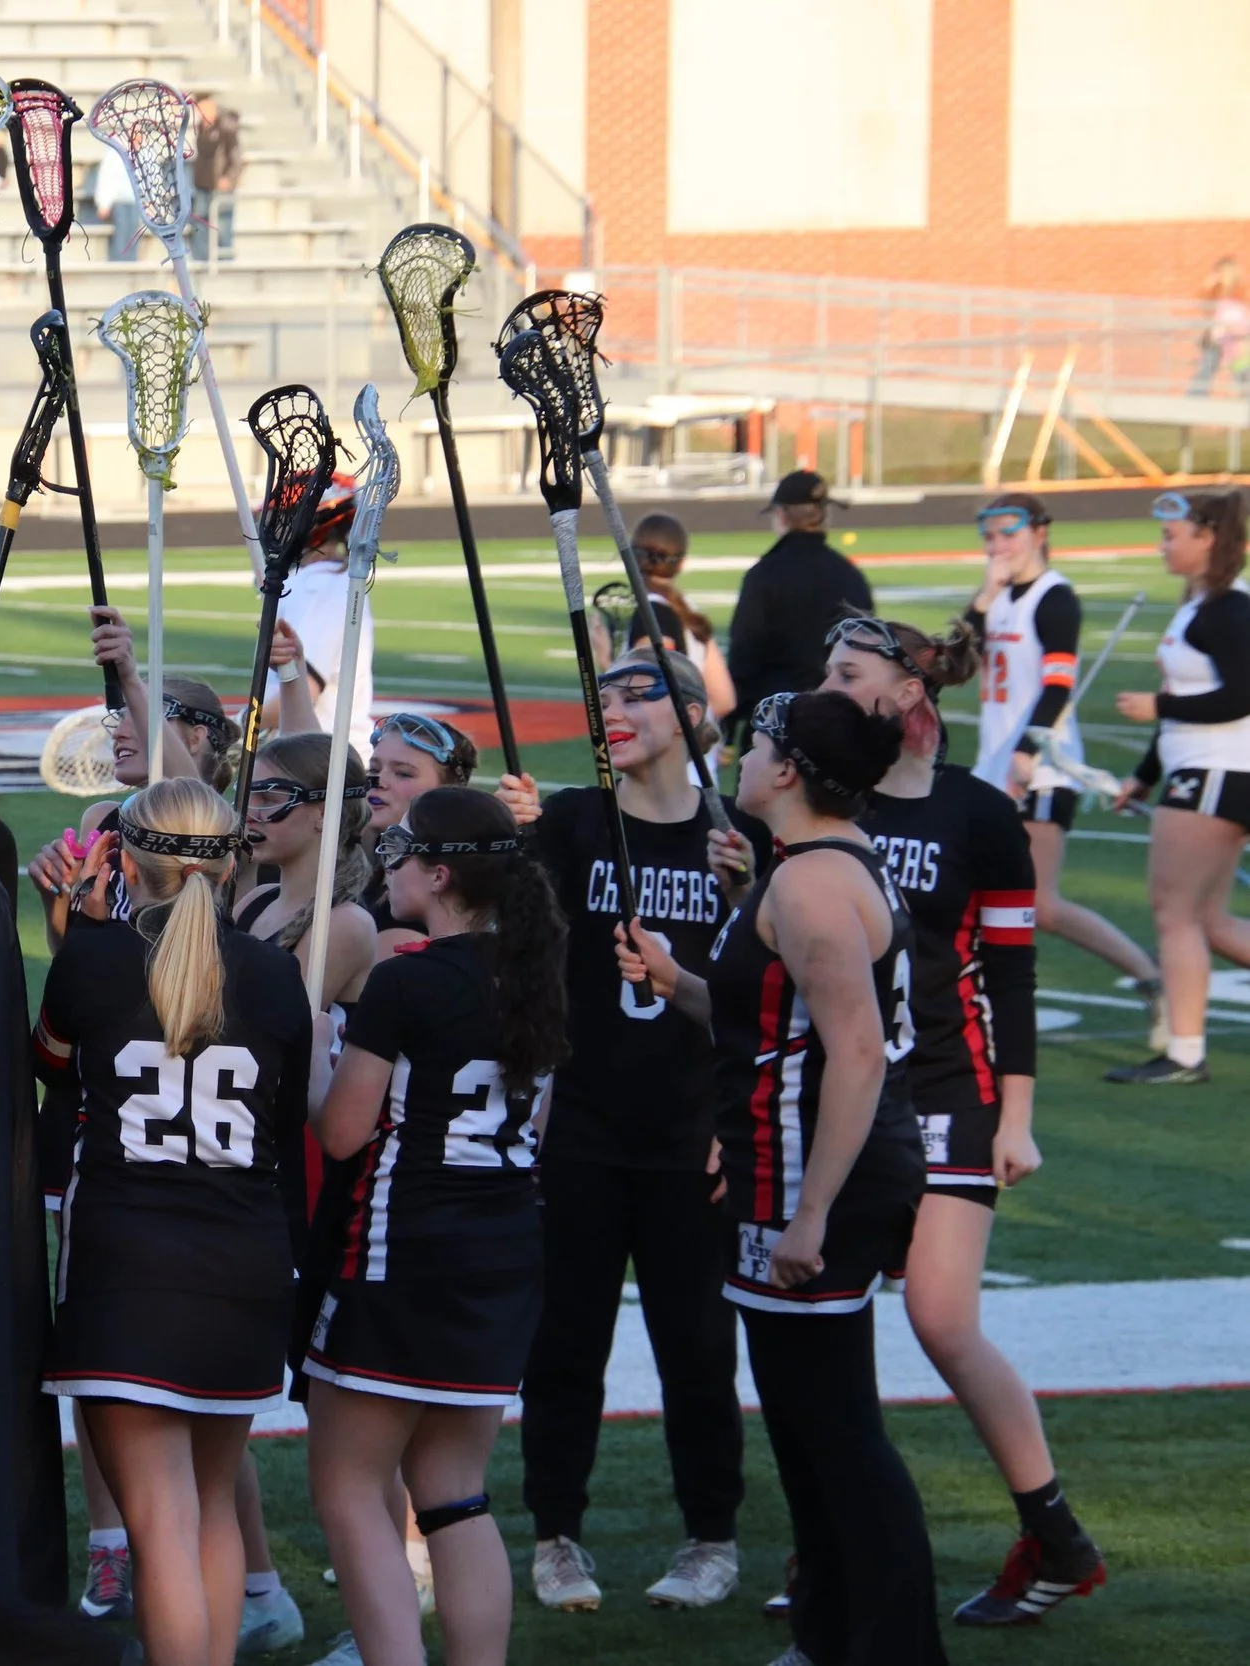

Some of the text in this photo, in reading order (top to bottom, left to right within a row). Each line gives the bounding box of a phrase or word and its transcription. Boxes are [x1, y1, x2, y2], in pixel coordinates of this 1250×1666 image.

[309, 790, 327, 801] ST
[146, 832, 178, 846] STX
[190, 836, 221, 847] STX
[410, 843, 430, 853] TX
[441, 842, 478, 852] STX
[114, 1040, 260, 1168] 26
